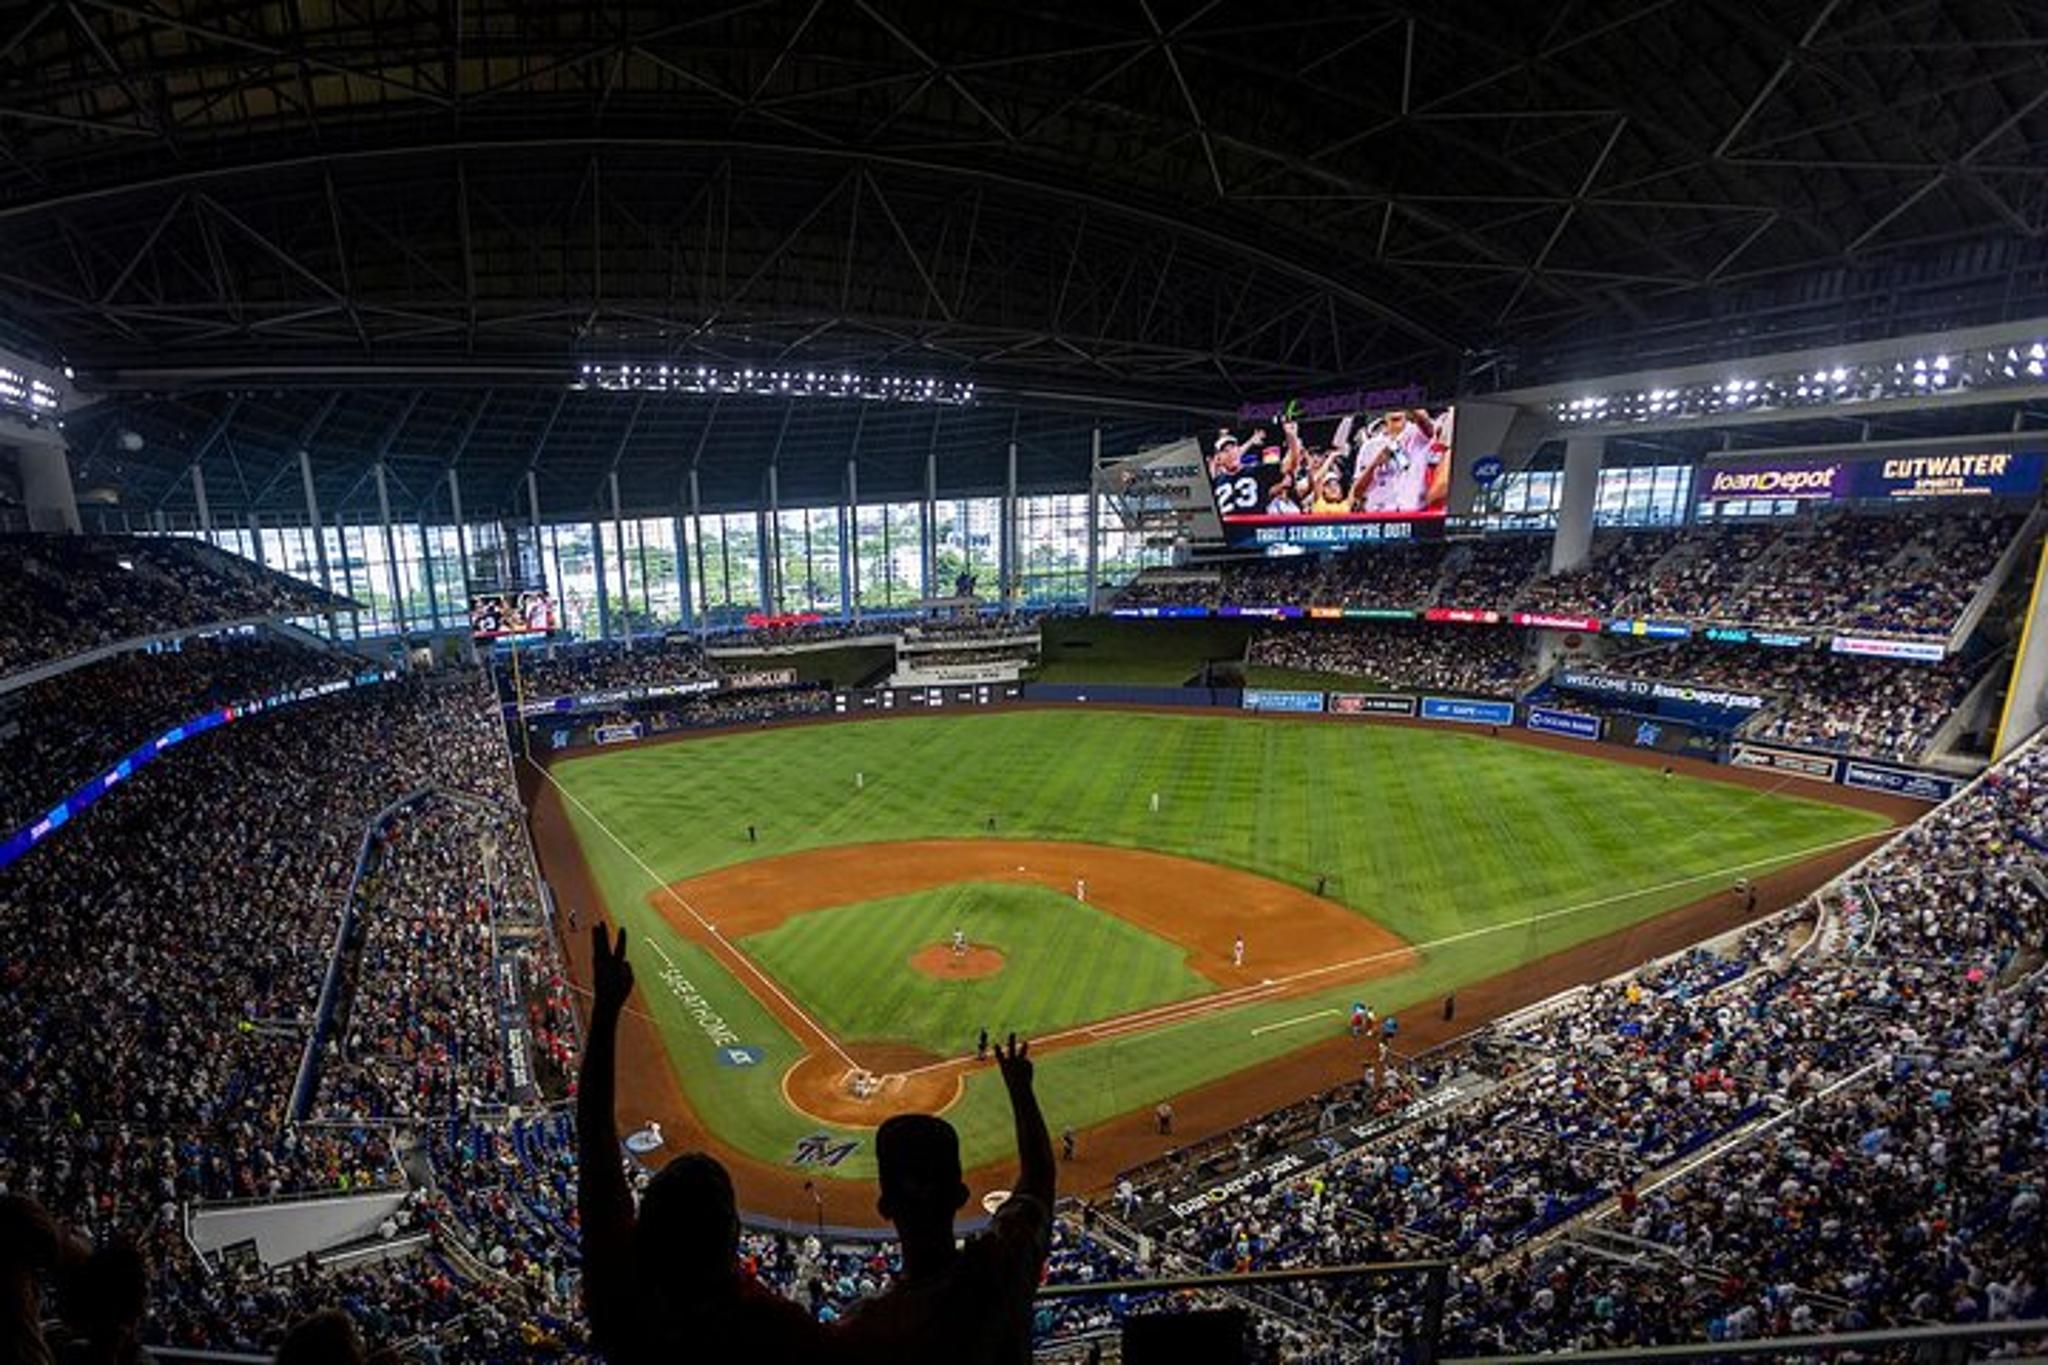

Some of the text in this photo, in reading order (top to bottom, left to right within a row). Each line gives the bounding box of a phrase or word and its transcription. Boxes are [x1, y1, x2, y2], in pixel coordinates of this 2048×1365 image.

[1711, 466, 1836, 492] loanDepot
[1883, 454, 2007, 479] CUTWATER
[1565, 674, 1627, 692] WELCOME
[1631, 682, 1648, 694] TO
